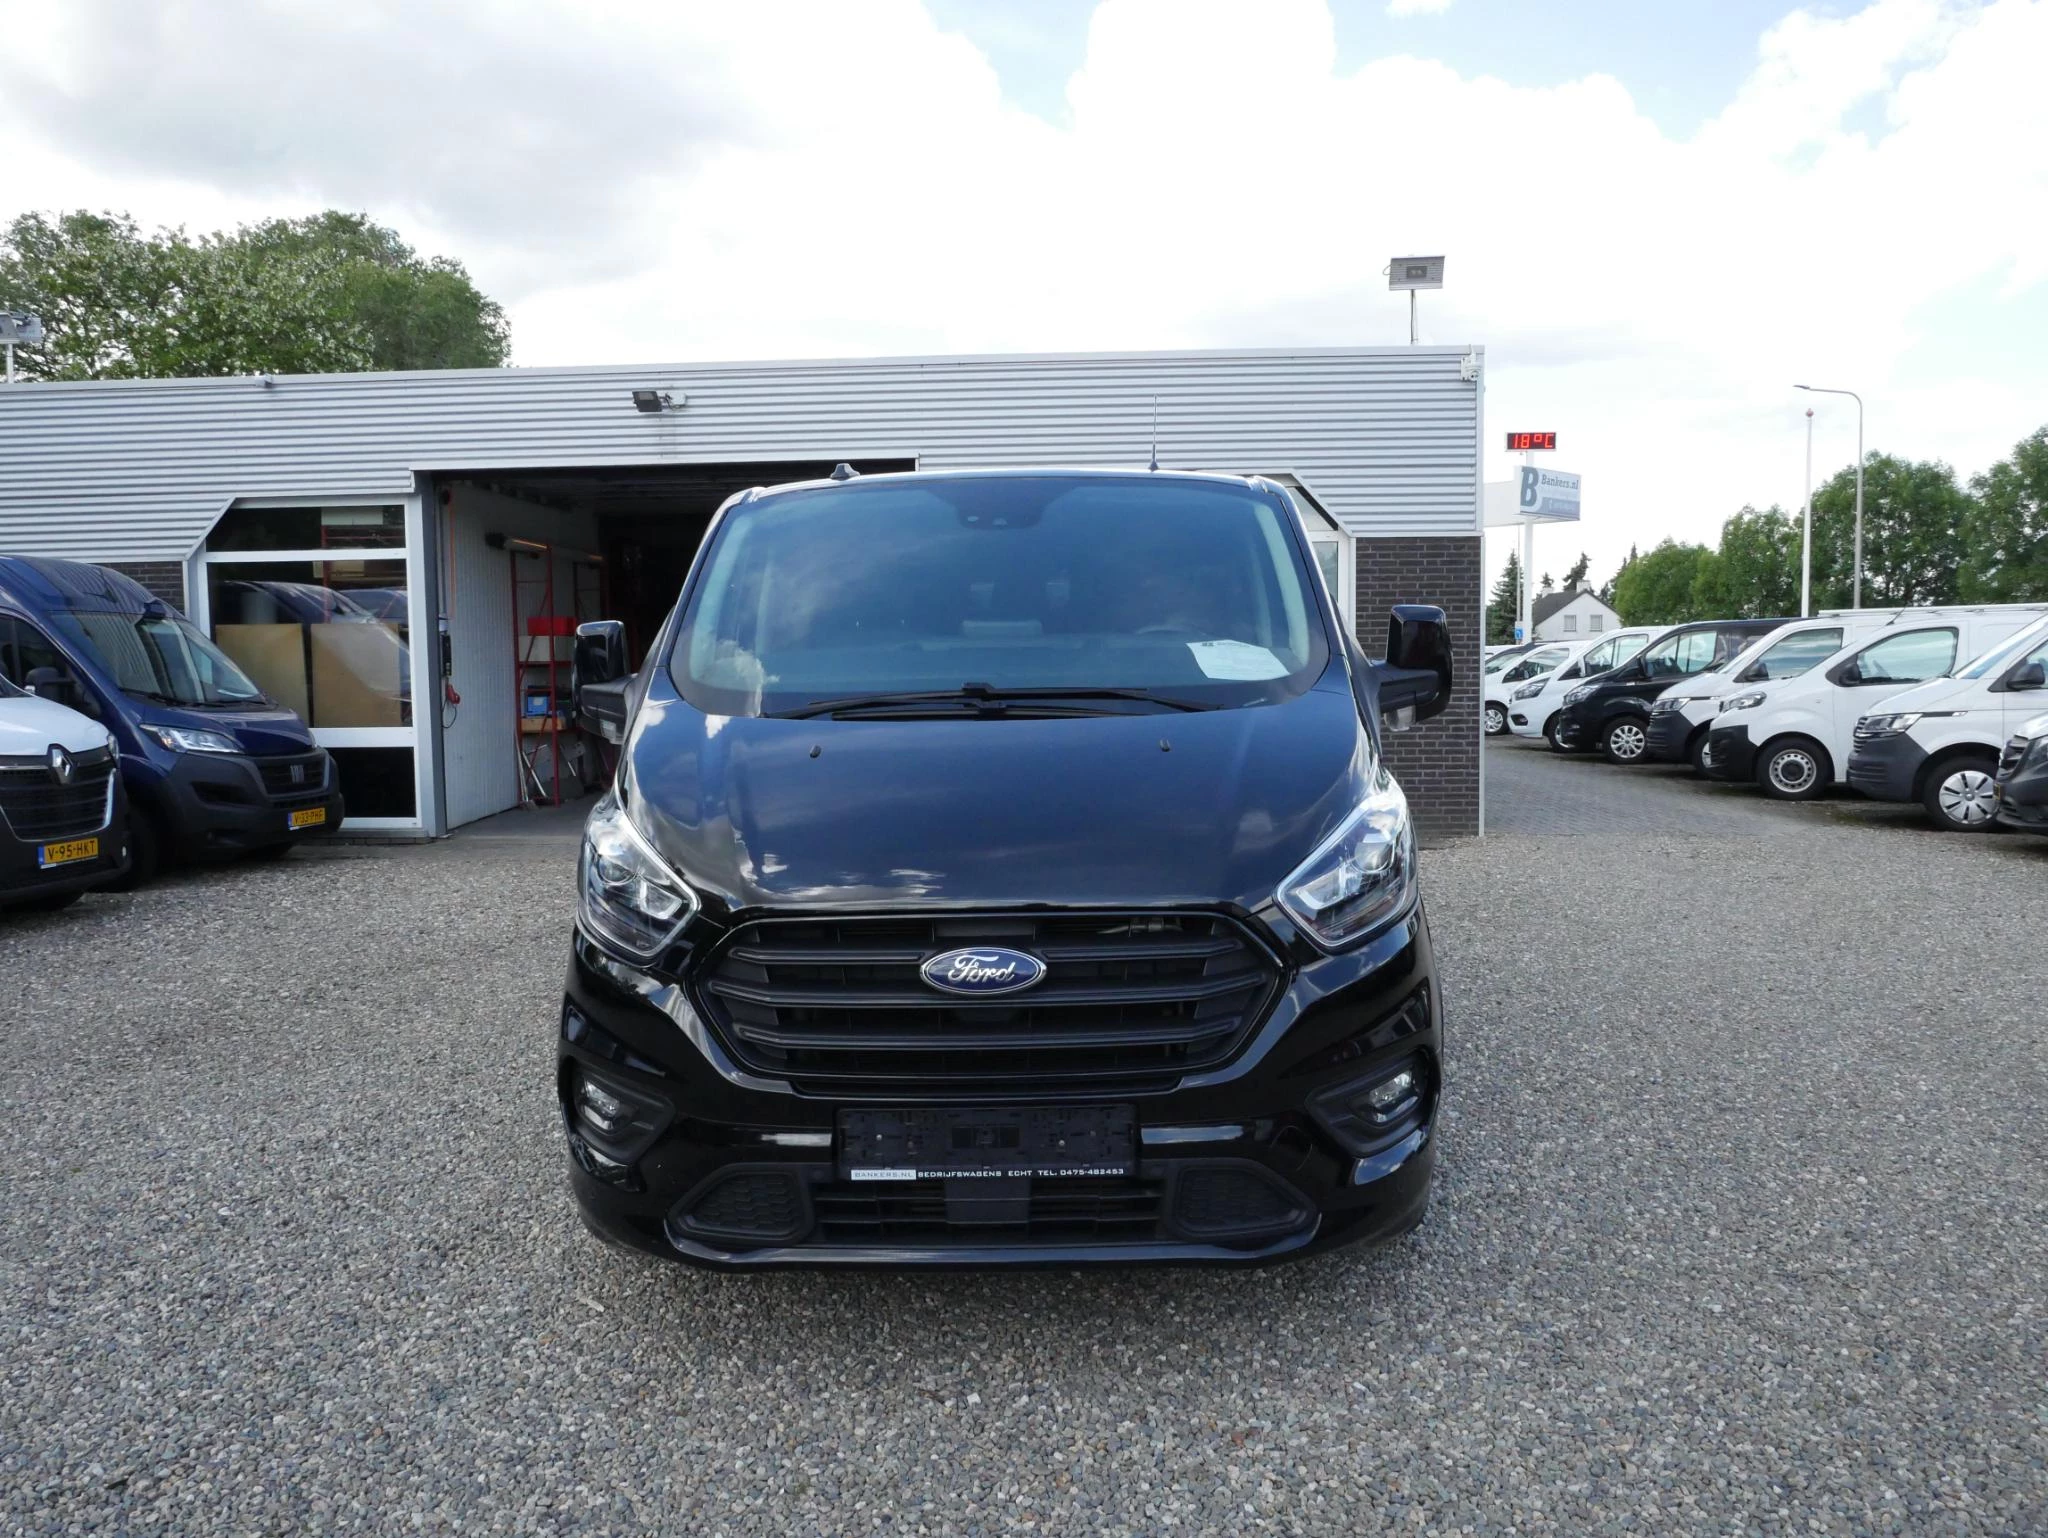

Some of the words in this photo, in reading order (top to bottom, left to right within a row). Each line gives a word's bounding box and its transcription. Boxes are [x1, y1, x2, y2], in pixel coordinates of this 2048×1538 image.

[1520, 466, 1540, 507] B
[1541, 473, 1579, 490] Bankers.nl
[47, 840, 95, 860] V-95-HKT
[947, 954, 1016, 983] Ford
[854, 1171, 914, 1179] BANKERS.NL
[917, 1170, 1002, 1178] BEDRIJFSWAGENS
[1008, 1169, 1033, 1177] ECHT
[1060, 1168, 1124, 1176] 0475-482453
